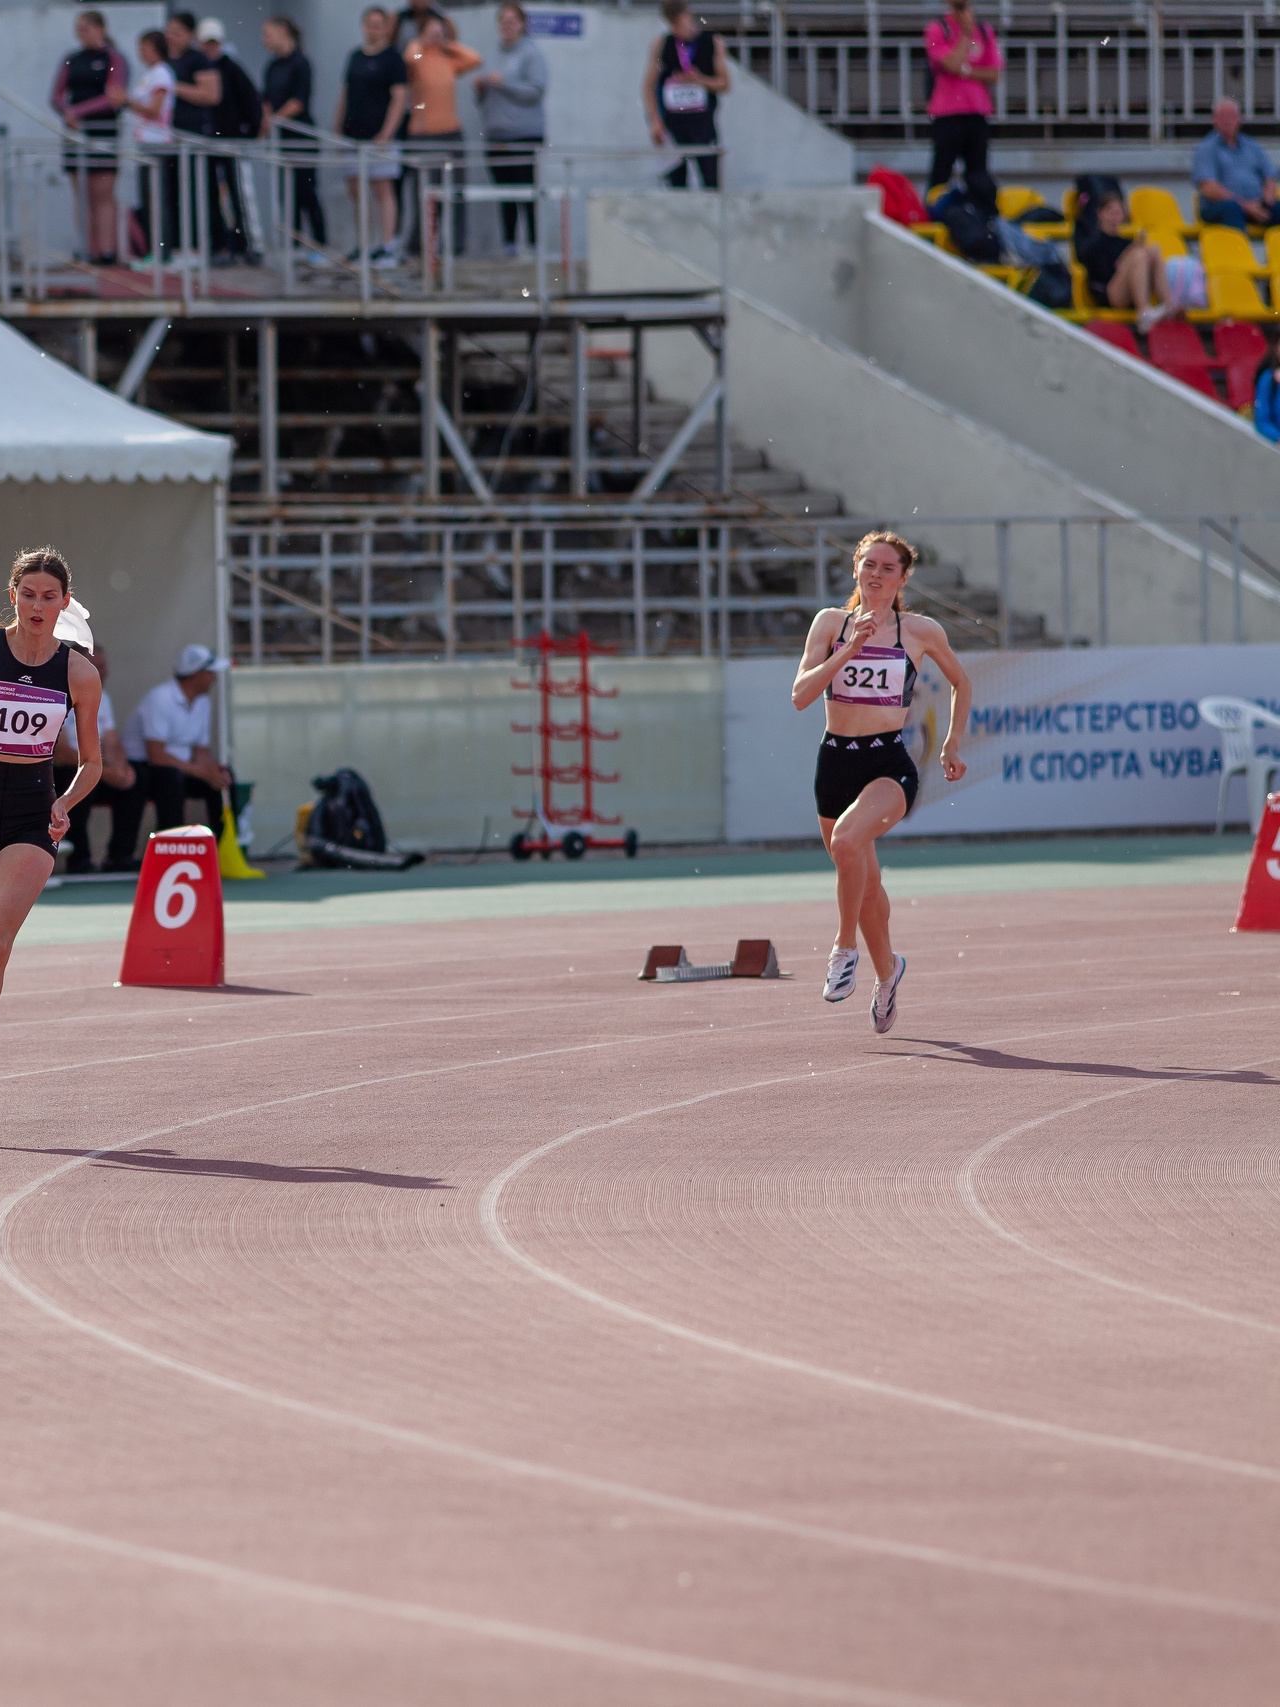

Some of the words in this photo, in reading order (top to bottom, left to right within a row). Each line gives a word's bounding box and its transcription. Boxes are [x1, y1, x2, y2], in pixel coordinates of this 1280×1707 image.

[843, 665, 889, 690] 321
[971, 702, 1200, 734] МИНИСТЕРСТВО
[1003, 754, 1021, 782] И
[1029, 749, 1142, 783] СПОРТА
[155, 843, 207, 855] MONDO
[153, 859, 203, 930] 6
